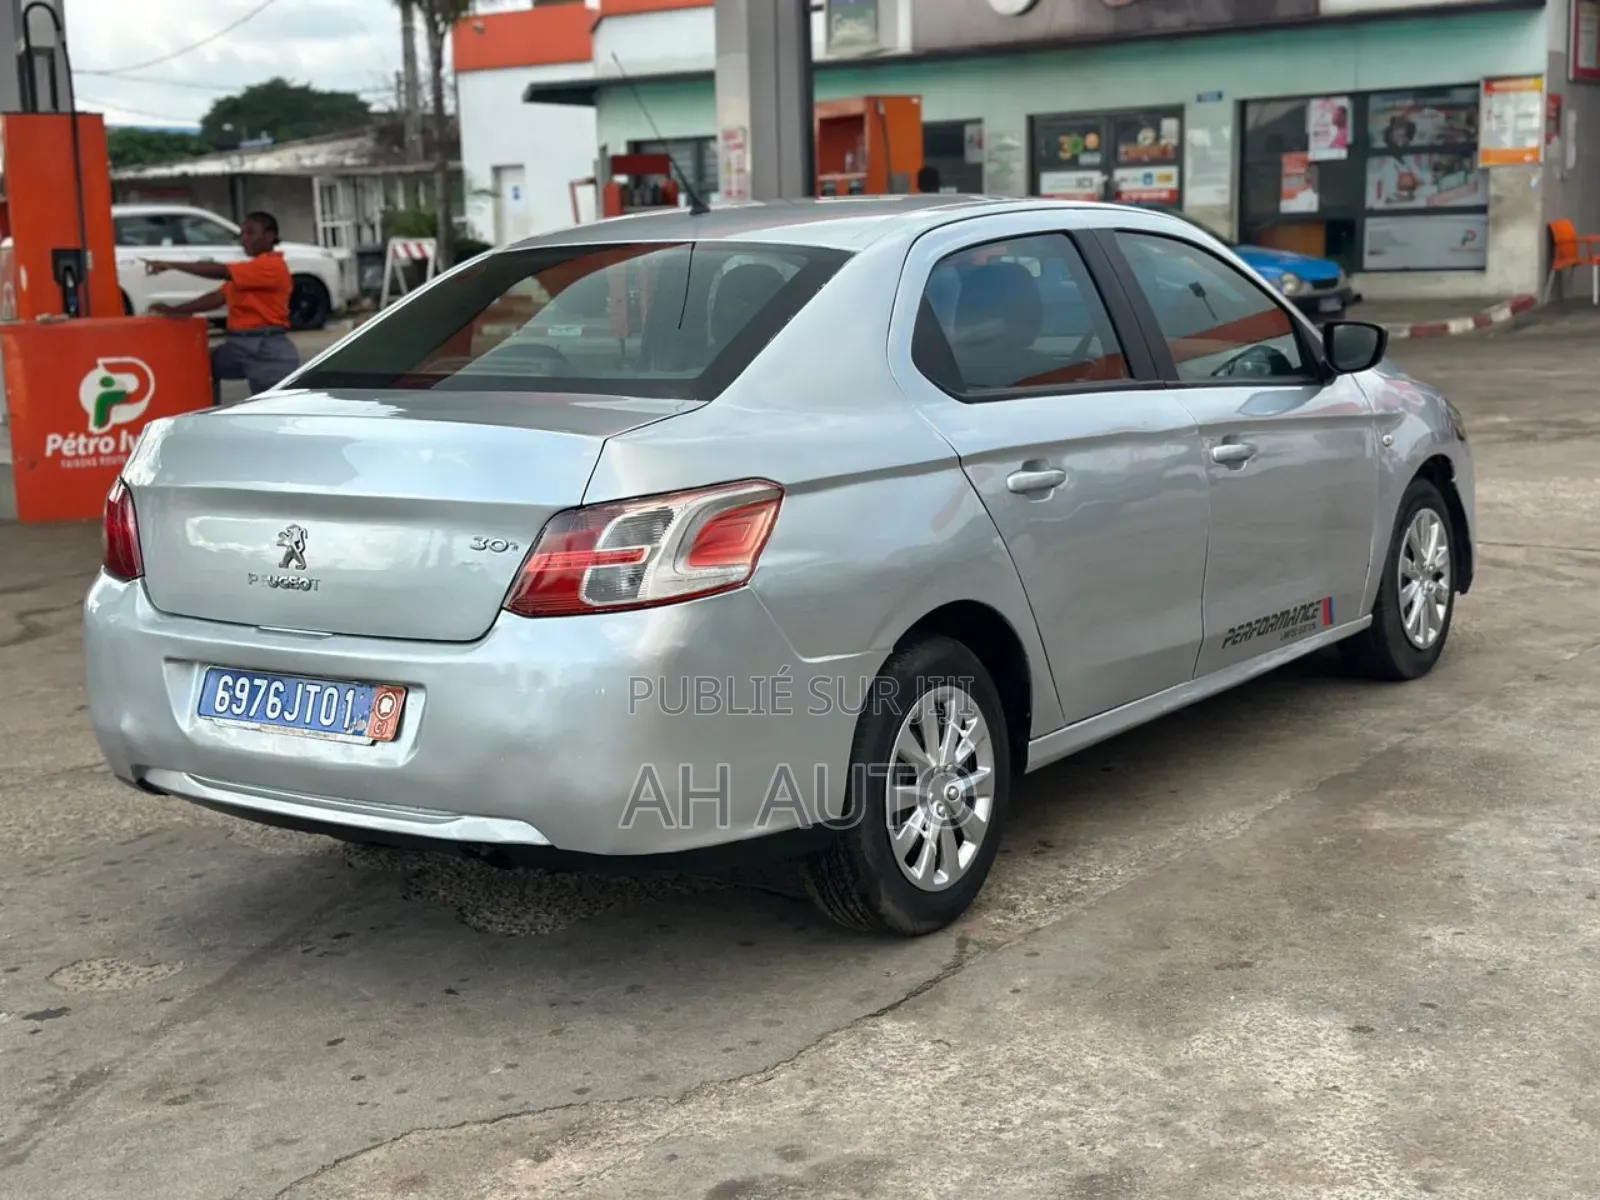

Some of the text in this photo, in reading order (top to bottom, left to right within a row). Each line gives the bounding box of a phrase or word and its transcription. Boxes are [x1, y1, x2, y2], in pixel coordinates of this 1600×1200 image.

[45, 432, 116, 458] Pétro
[1221, 599, 1322, 649] PERFORMANCE
[214, 674, 356, 734] 6976JT01
